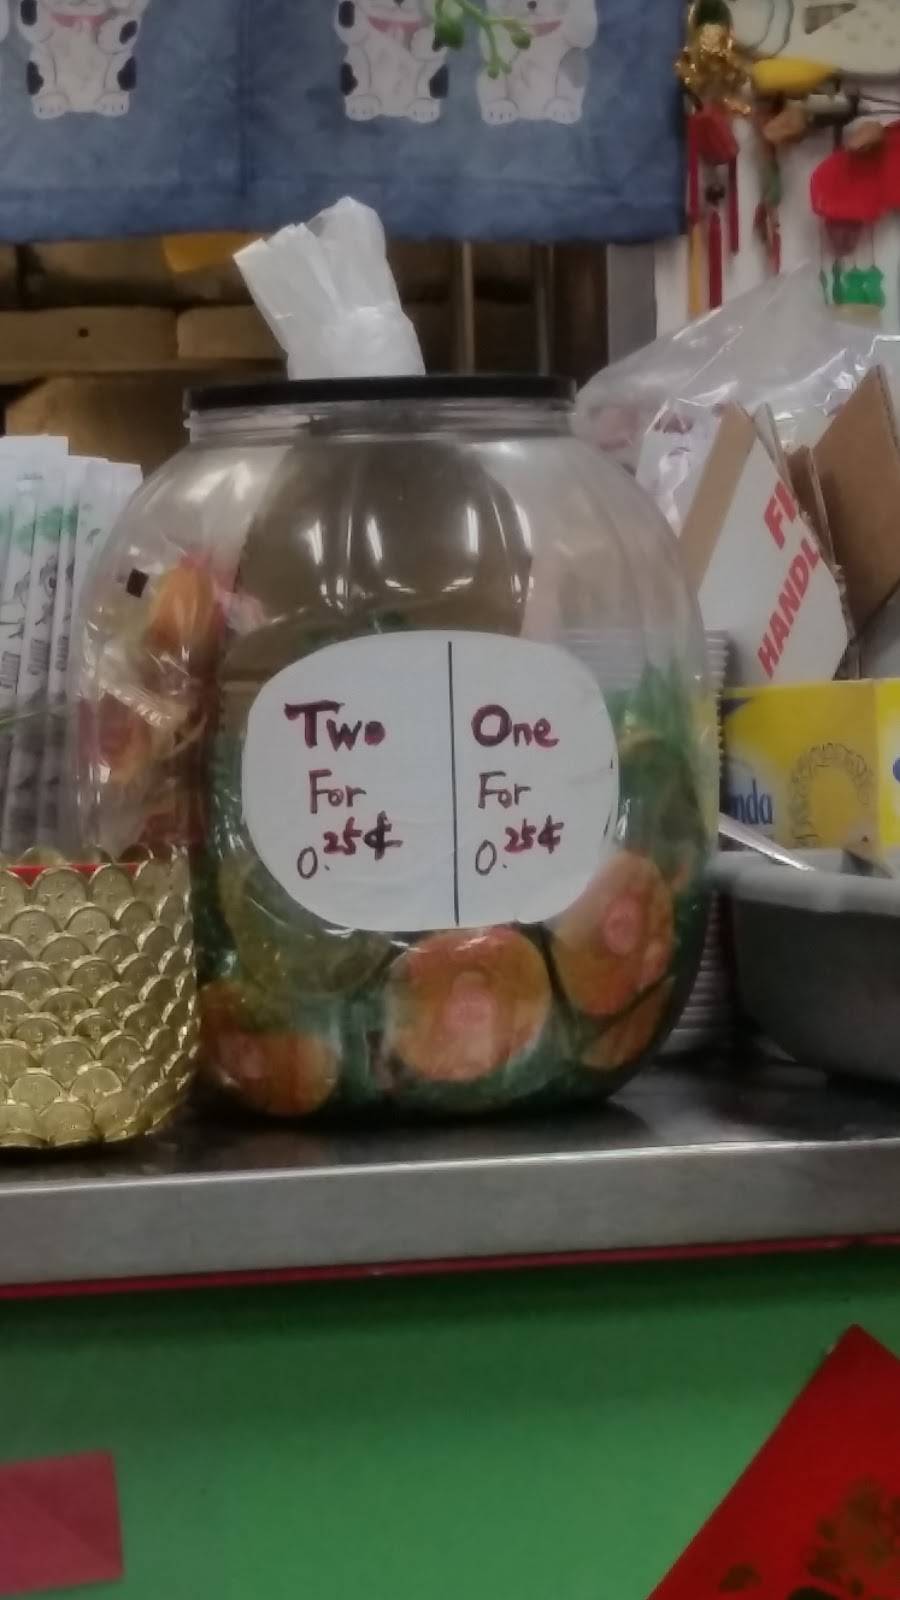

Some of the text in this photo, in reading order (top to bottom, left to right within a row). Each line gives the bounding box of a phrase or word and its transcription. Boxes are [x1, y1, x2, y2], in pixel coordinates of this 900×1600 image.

[284, 699, 387, 751] Two
[471, 704, 559, 748] One
[308, 769, 367, 815] For
[477, 771, 532, 810] For
